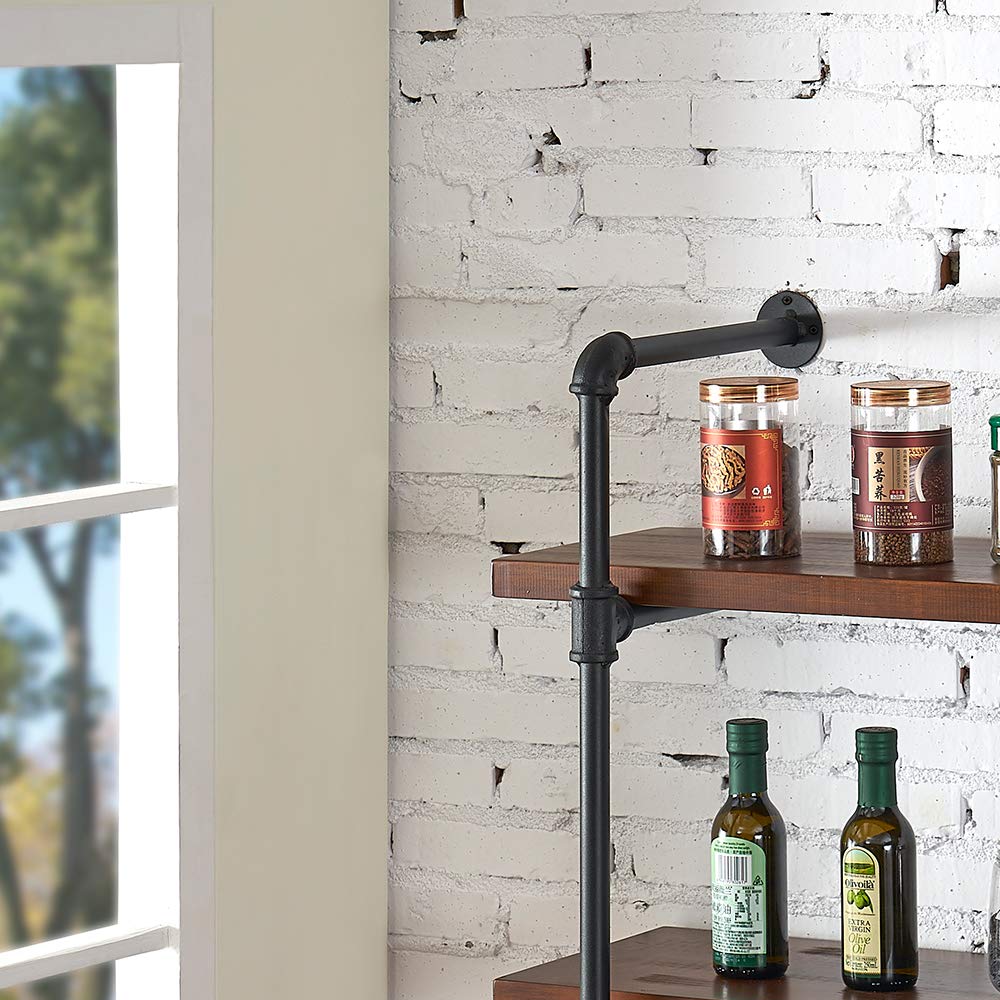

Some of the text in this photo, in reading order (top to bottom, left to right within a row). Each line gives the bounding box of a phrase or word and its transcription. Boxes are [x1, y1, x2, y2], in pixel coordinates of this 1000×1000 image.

[848, 919, 871, 927] EXTRA
[848, 933, 871, 945] Olive
[852, 943, 866, 954] Oil
